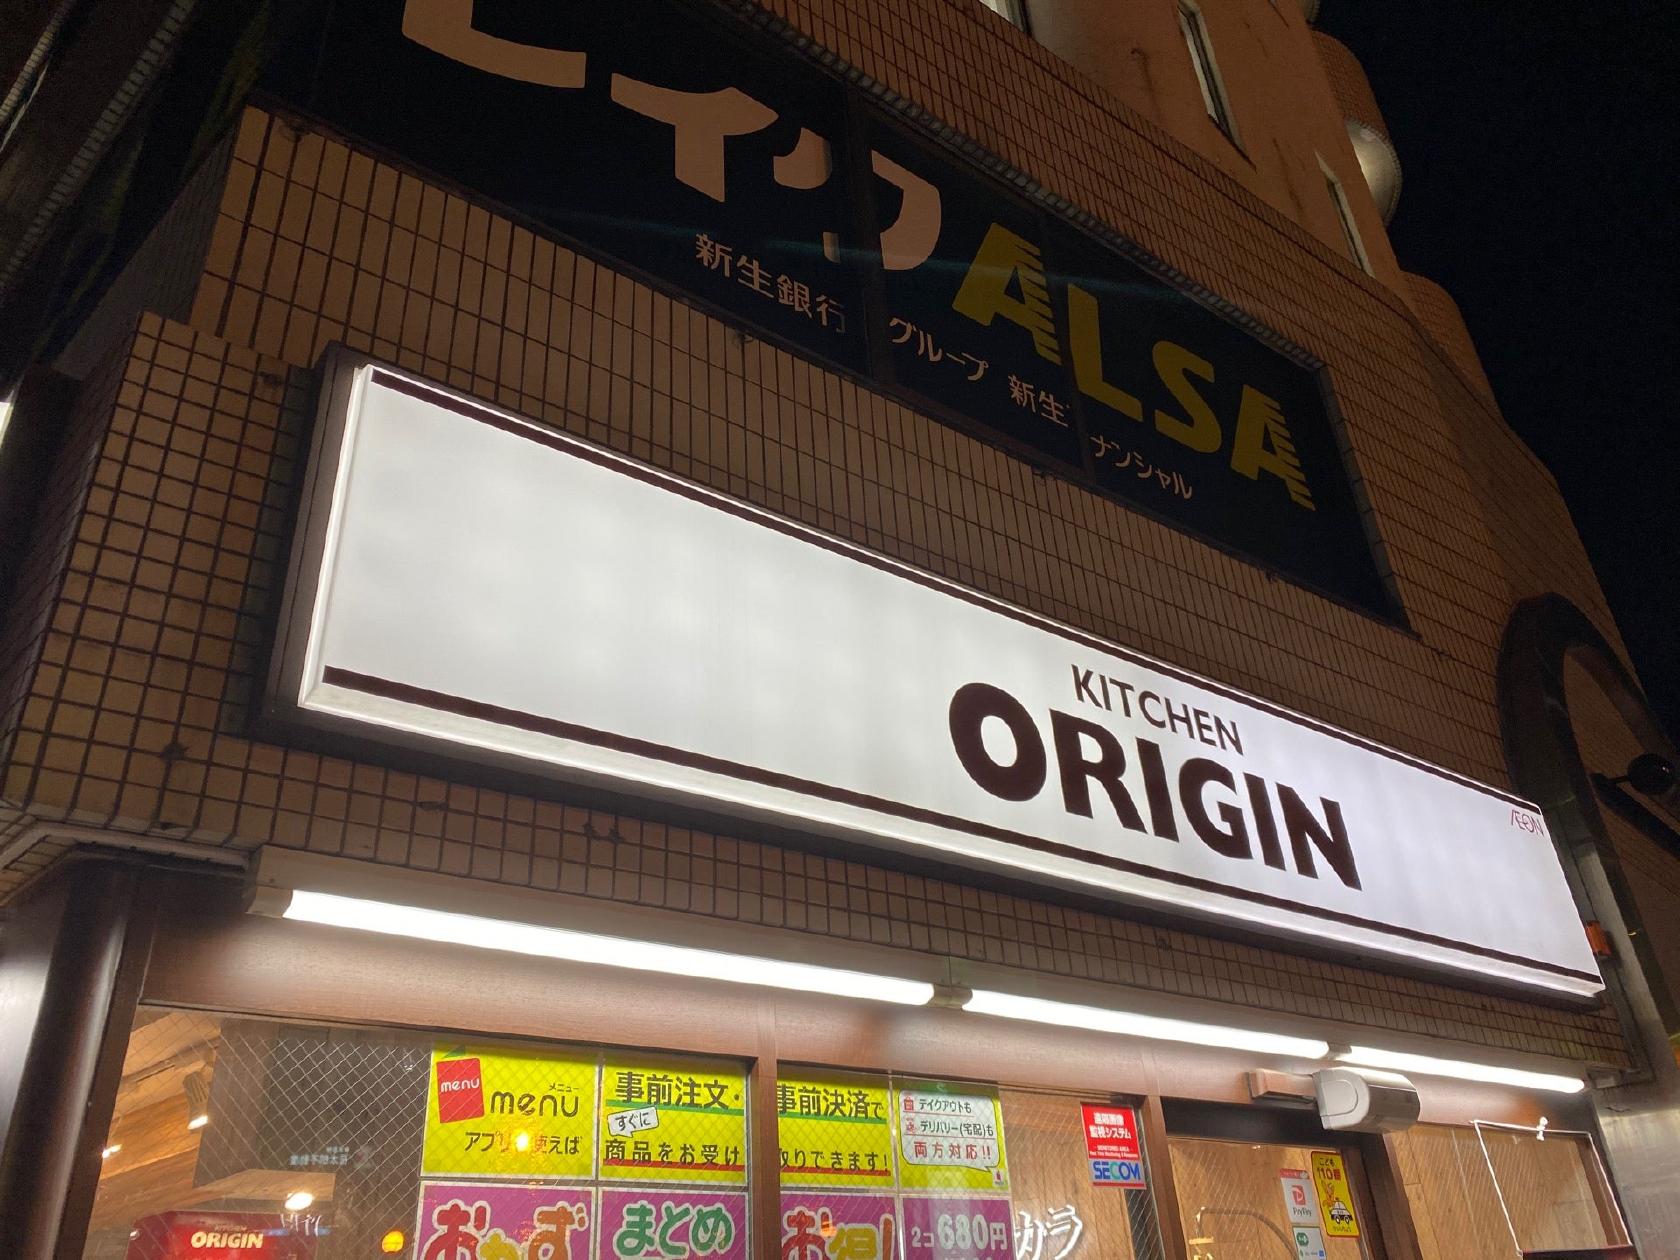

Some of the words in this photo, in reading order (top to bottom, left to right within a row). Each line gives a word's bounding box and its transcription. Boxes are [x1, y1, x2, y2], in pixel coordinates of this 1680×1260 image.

[695, 233, 848, 333] 新生銀行
[890, 316, 990, 382] グループ
[953, 222, 1315, 511] ALSA
[1071, 664, 1245, 757] KITCHEN
[949, 682, 1362, 890] ORIGIN
[440, 1077, 481, 1093] menu
[549, 1083, 579, 1093] メニュー
[490, 1091, 580, 1118] menu
[777, 1084, 884, 1121] 事前決済で
[919, 1098, 972, 1114] テイクアウトも
[615, 1112, 651, 1132] すぐに
[920, 1120, 994, 1137] デリバリー(宅配)も
[1089, 1125, 1131, 1139] 監視システム
[605, 1138, 740, 1166] 商品をお受け
[1092, 1160, 1141, 1180] SECOM
[191, 1231, 264, 1249] ORIGIN
[614, 1200, 736, 1258] まとめ
